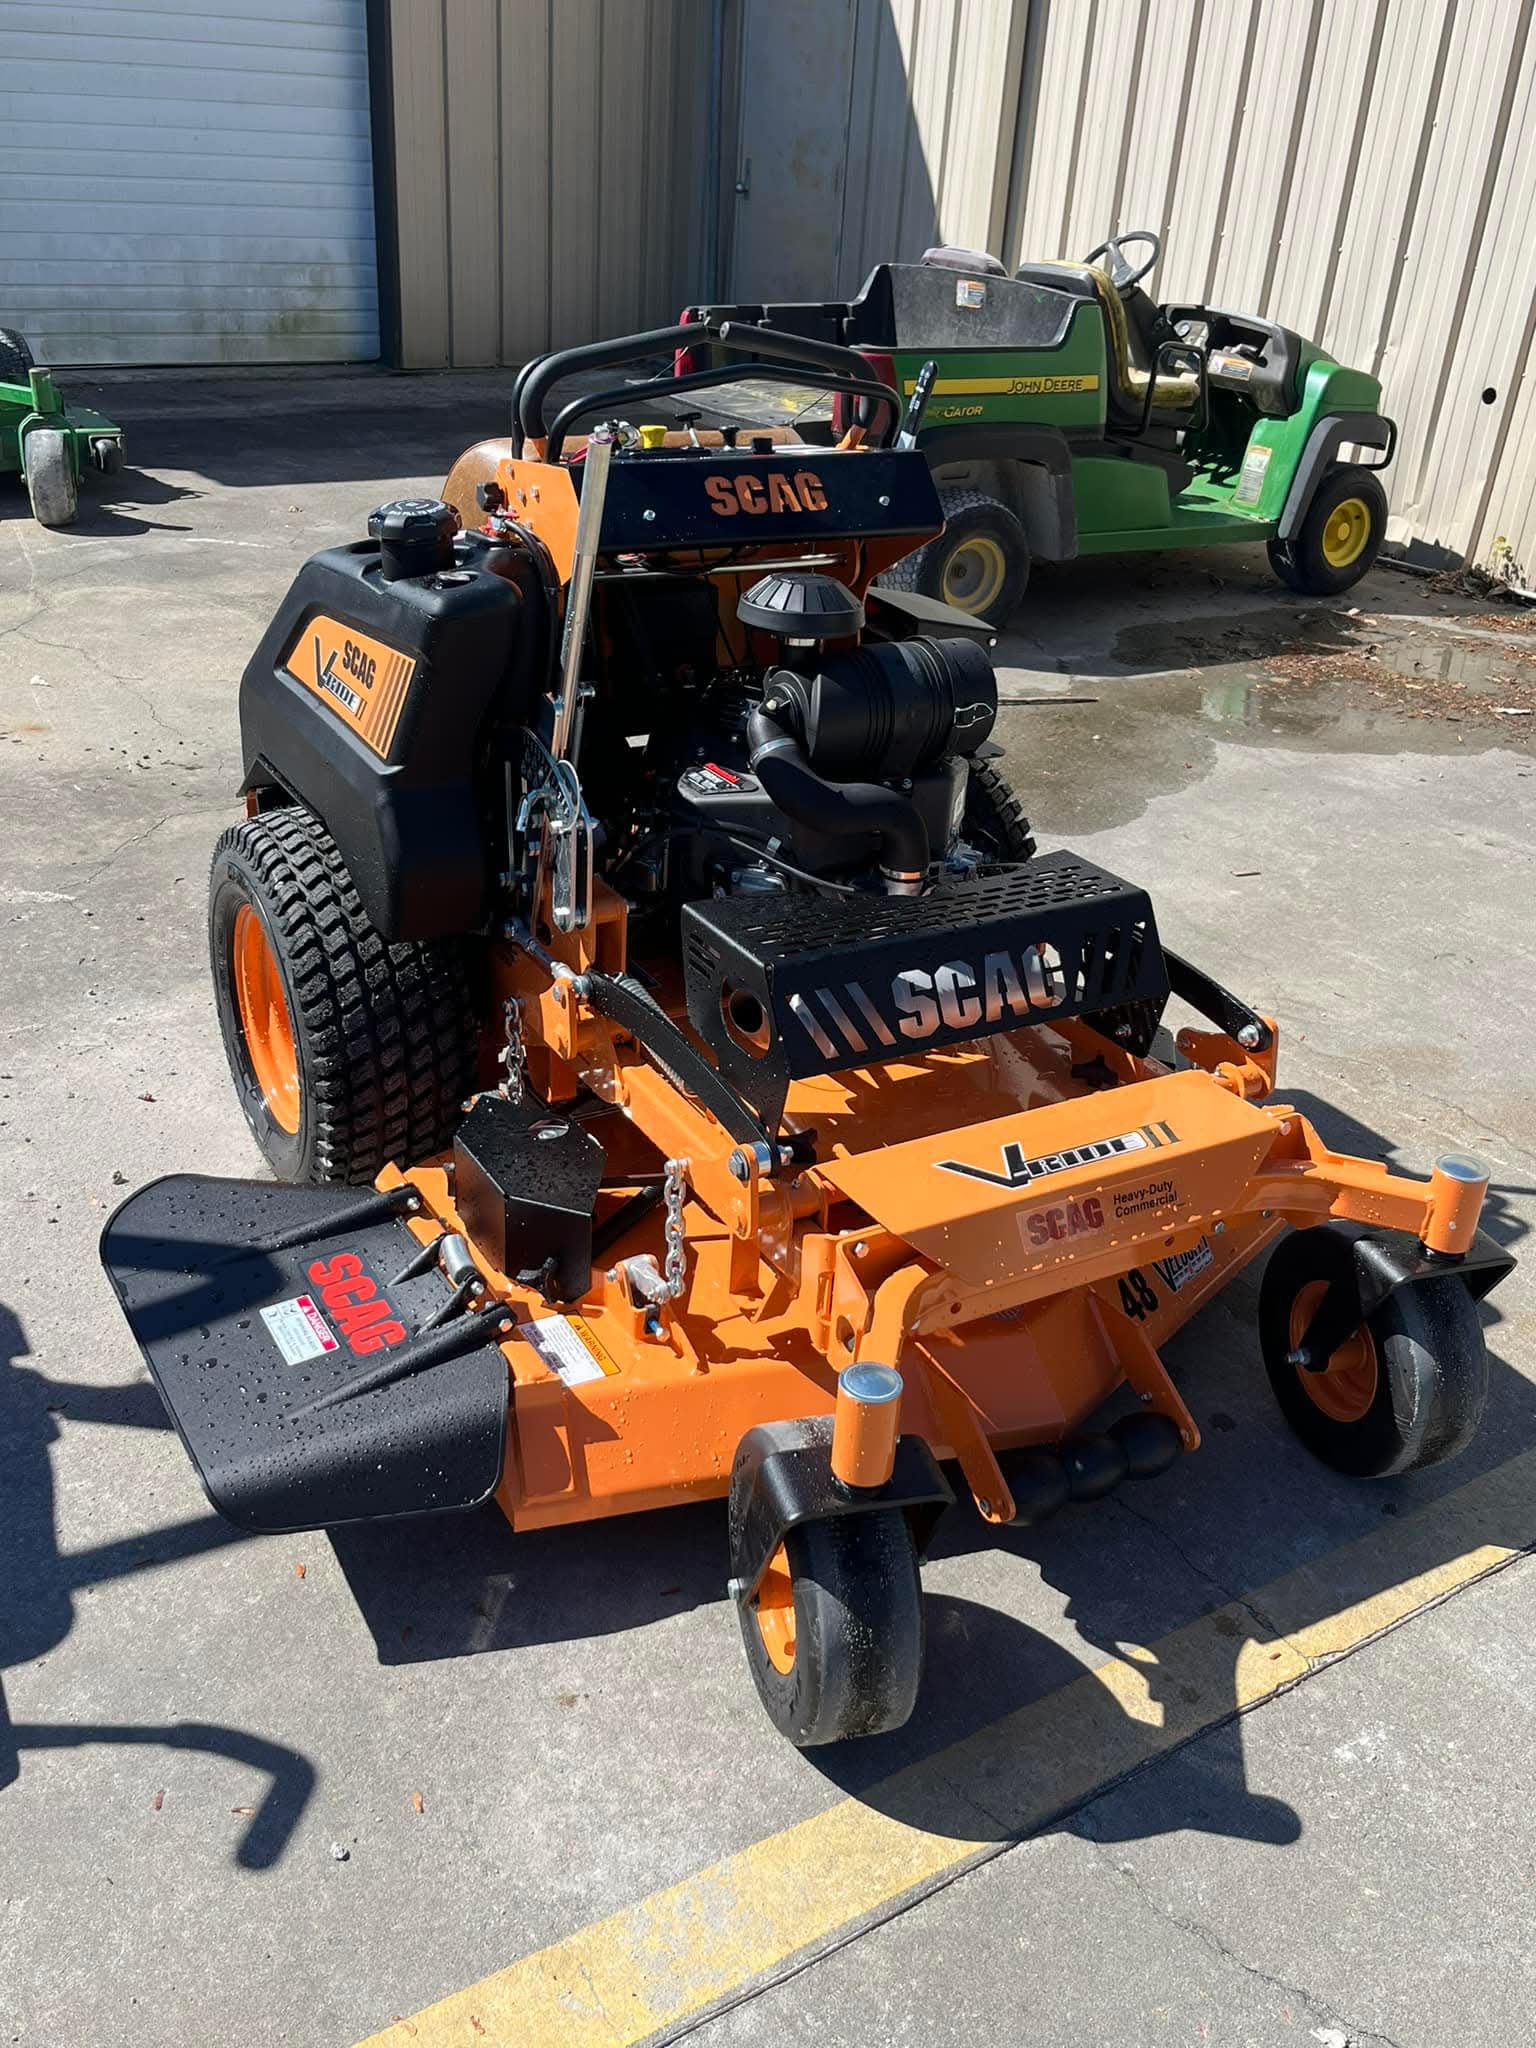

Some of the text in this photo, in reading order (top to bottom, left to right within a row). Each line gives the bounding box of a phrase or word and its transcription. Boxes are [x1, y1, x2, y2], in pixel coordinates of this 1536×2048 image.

[1008, 378, 1083, 393] JOHN DEERE
[704, 472, 828, 515] SCAG
[343, 640, 376, 689] SCAG
[891, 942, 1067, 1039] SCAG
[1140, 1120, 1181, 1148] II
[1113, 1180, 1173, 1206] Heavy-Duty
[1115, 1191, 1178, 1218] Commercial
[1027, 1197, 1105, 1245] SCAG
[308, 1253, 406, 1354] SCAG
[1118, 1268, 1158, 1321] 48
[307, 1312, 334, 1342] DANGER
[581, 1328, 607, 1362] WARNING
